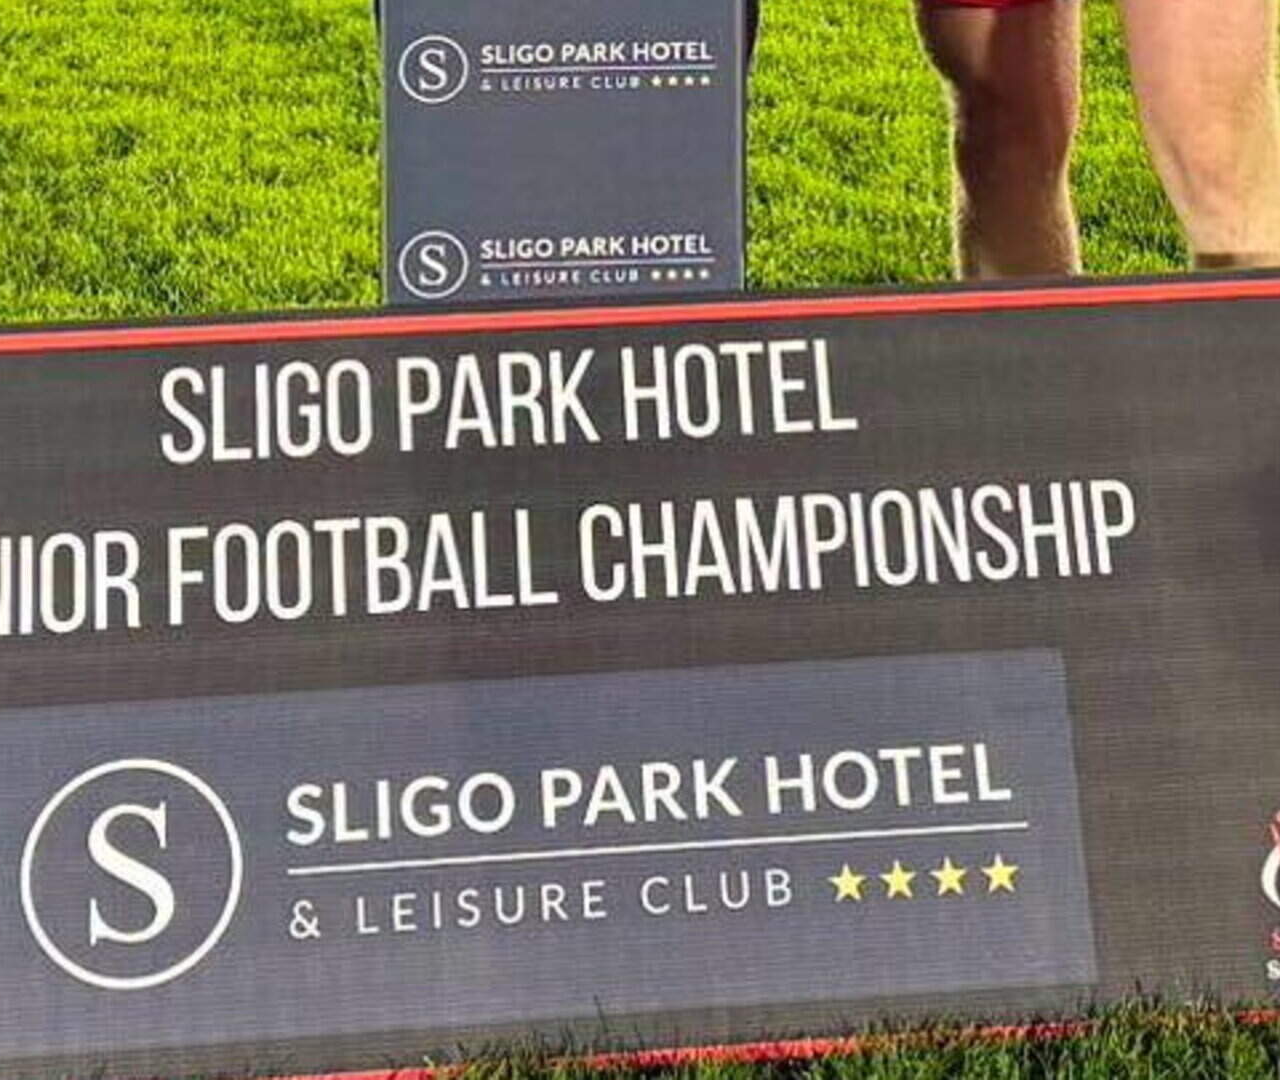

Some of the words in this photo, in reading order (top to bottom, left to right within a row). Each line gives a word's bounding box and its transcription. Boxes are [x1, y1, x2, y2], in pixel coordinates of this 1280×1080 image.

[480, 43, 554, 65] SLIGO
[561, 41, 626, 63] PARK
[632, 40, 713, 62] HOTEL
[501, 75, 582, 92] LEISURE
[590, 74, 641, 89] CLUB
[480, 237, 554, 260] SLIGO
[560, 235, 625, 258] PARK
[631, 233, 712, 255] HOTEL
[501, 270, 581, 287] LEISURE
[589, 268, 640, 284] CLUB
[160, 358, 373, 464] SLIGO
[397, 347, 601, 452] PARK
[621, 338, 859, 441] HOTEL
[168, 508, 560, 625] FOOTBALL
[579, 479, 1136, 601] CHAMPIONSHIP
[286, 772, 516, 846] SLIGO
[541, 757, 743, 828] PARK
[764, 743, 1013, 814] HOTEL
[88, 801, 175, 946] S
[289, 900, 321, 939] &
[356, 879, 608, 934] LEISURE
[640, 868, 793, 915] CLUB
